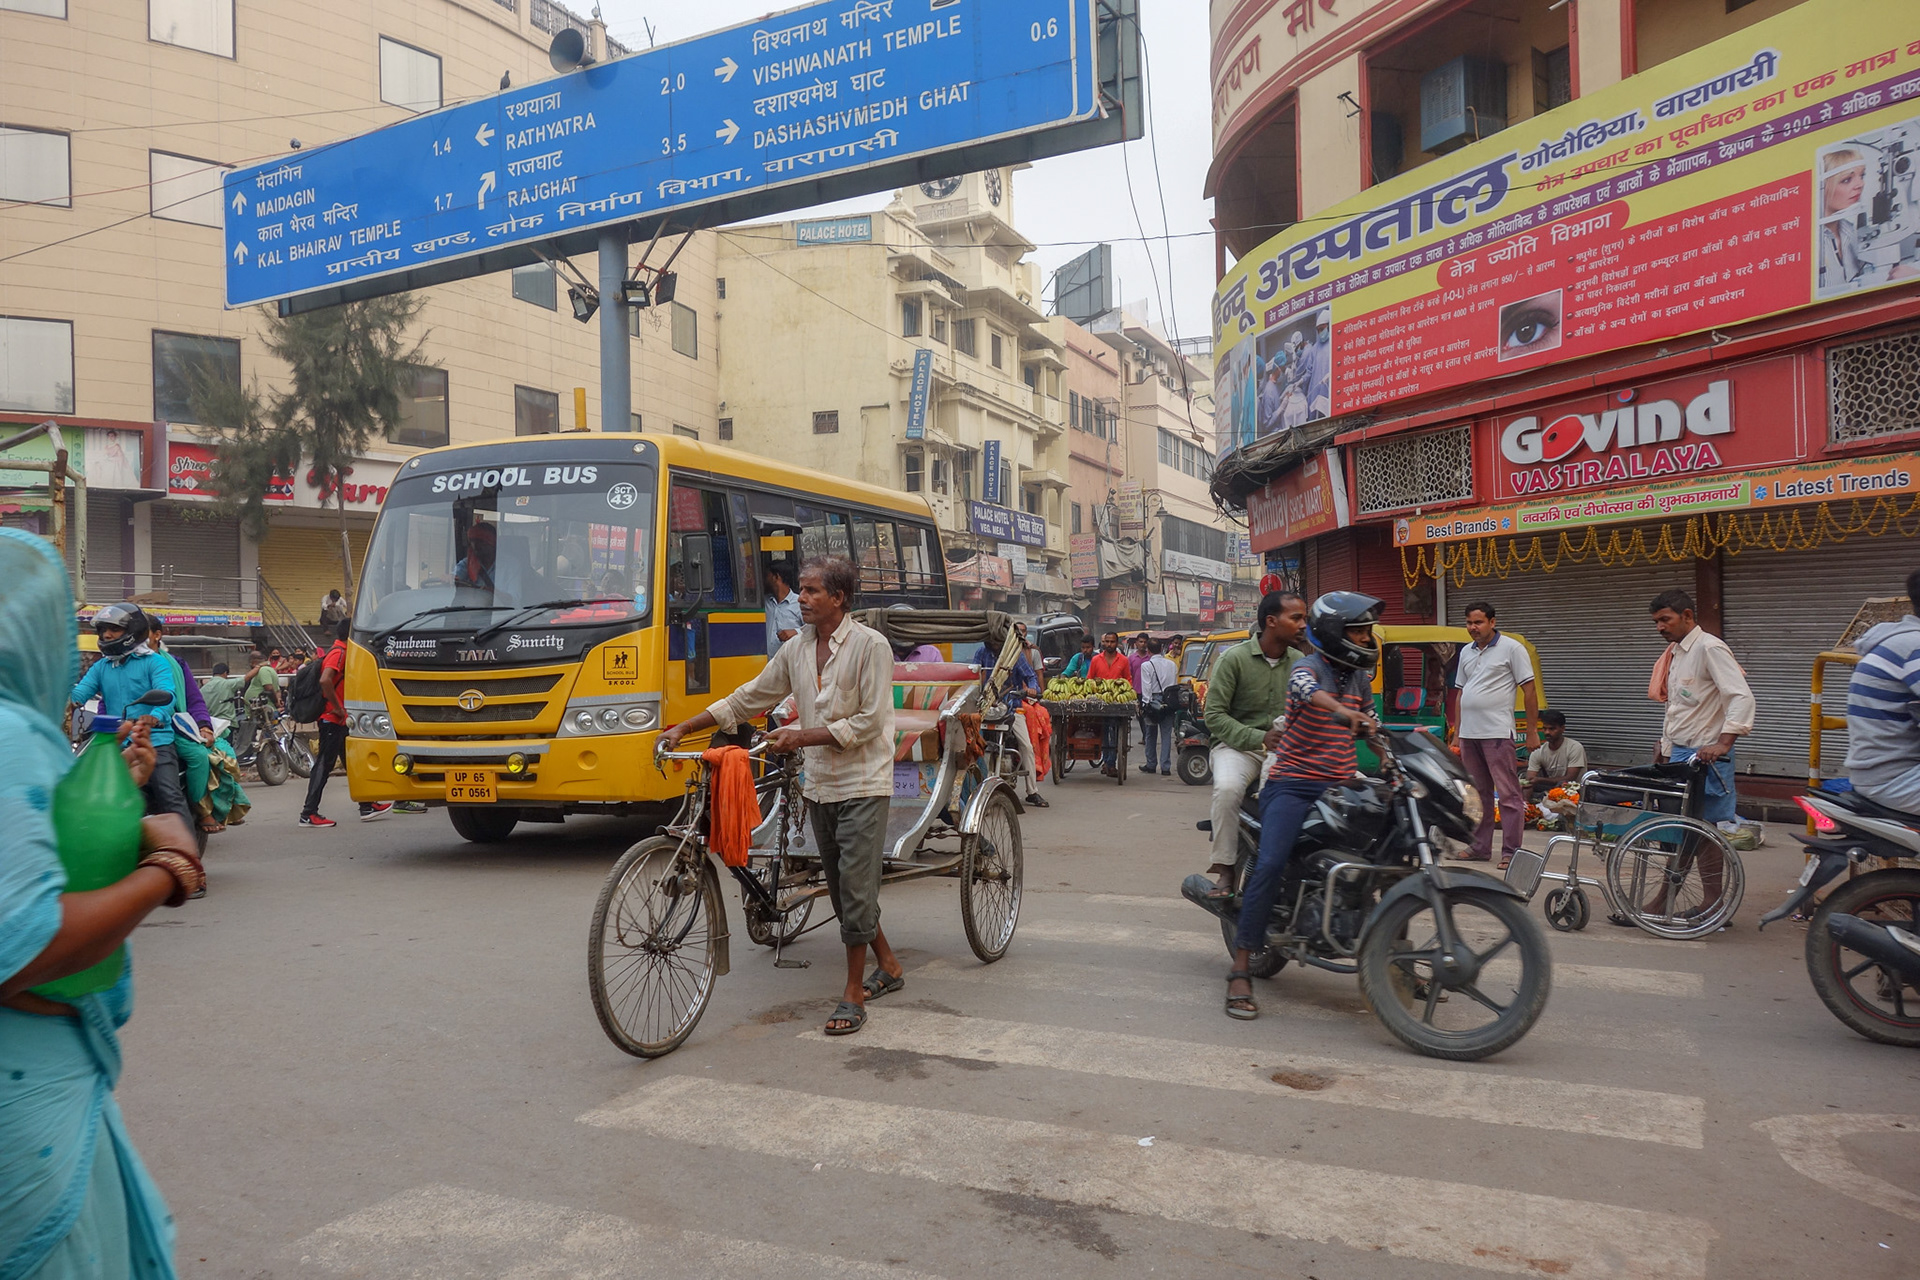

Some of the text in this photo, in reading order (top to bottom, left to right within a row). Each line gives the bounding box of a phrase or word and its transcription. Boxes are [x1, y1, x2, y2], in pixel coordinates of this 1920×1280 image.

[752, 0, 894, 56] विश्वनाथ मन्दिर
[1030, 17, 1058, 42] 0.6
[752, 15, 962, 86] VISHWANATH TEMPLE
[660, 72, 686, 95] 2.0
[753, 68, 886, 117] दशाश्वमेध घाट
[506, 92, 561, 121] रथयात्रा
[754, 80, 971, 150] DASHASHVMEDH GHAT
[1571, 149, 1631, 180] उपचार
[1634, 136, 1662, 156] का
[1752, 88, 1787, 112] का
[1793, 69, 1838, 99] एक
[1845, 48, 1899, 79] मात्र
[506, 112, 596, 150] RATHYATRA
[662, 133, 687, 155] 3.5
[433, 137, 451, 156] 1.4
[508, 150, 563, 177] राजघाट
[1256, 153, 1517, 300] अस्पताल
[1522, 122, 1645, 171] गोदौलिया,
[1655, 51, 1777, 117] वाराणसी
[508, 176, 578, 208] RAJGHAT
[1372, 268, 1381, 280] का
[1410, 254, 1422, 268] एक
[1447, 239, 1455, 254] से
[1459, 231, 1482, 250] अधिक
[1538, 206, 1548, 221] के
[1553, 192, 1591, 215] आपरेशन
[1596, 181, 1611, 202] एवं
[1649, 165, 1661, 182] के
[1761, 124, 1774, 143] के
[1783, 115, 1811, 135] 300
[1841, 91, 1882, 114] अधिक
[256, 188, 315, 217] MAIDAGIN
[326, 248, 401, 275] प्रान्तीय
[486, 214, 544, 237] लोक
[557, 191, 643, 221] निर्माण
[656, 167, 752, 199] विभाग,
[762, 128, 899, 173] वाराणसी
[434, 193, 453, 211] 1.7
[258, 203, 358, 242] काल भैरव मन्दिर
[800, 222, 869, 241] PALACE HOTEL
[1668, 224, 1678, 233] का
[258, 220, 401, 268] KAL BHAIRAV TEMPLE
[1450, 212, 1612, 279] नेत्र ज्योति विभाग
[1723, 269, 1730, 280] के
[1758, 258, 1770, 271] की
[1651, 309, 1661, 318] का
[1709, 288, 1745, 304] आपरेशन
[916, 353, 928, 392] PALACE
[912, 394, 922, 426] HOTEL
[1501, 379, 1735, 464] Govind
[171, 456, 207, 473] Shree
[1511, 442, 1722, 495] VASTRALAYA
[431, 466, 597, 493] SCHOOL BUS
[614, 486, 631, 495] SCT
[1775, 469, 1910, 499] Latest Trends
[610, 494, 634, 506] 43
[1522, 484, 1742, 524] नवरात्रि एवं दीपोत्सव की शुभकामनायें
[974, 505, 1010, 525] PALACE HOTEL
[1426, 518, 1497, 539] Best Brands
[384, 635, 437, 653] Sunbeam
[458, 650, 497, 661] TATA
[506, 635, 565, 652] Suncity
[455, 772, 485, 783] UP 65
[451, 787, 491, 798] GT 0561
